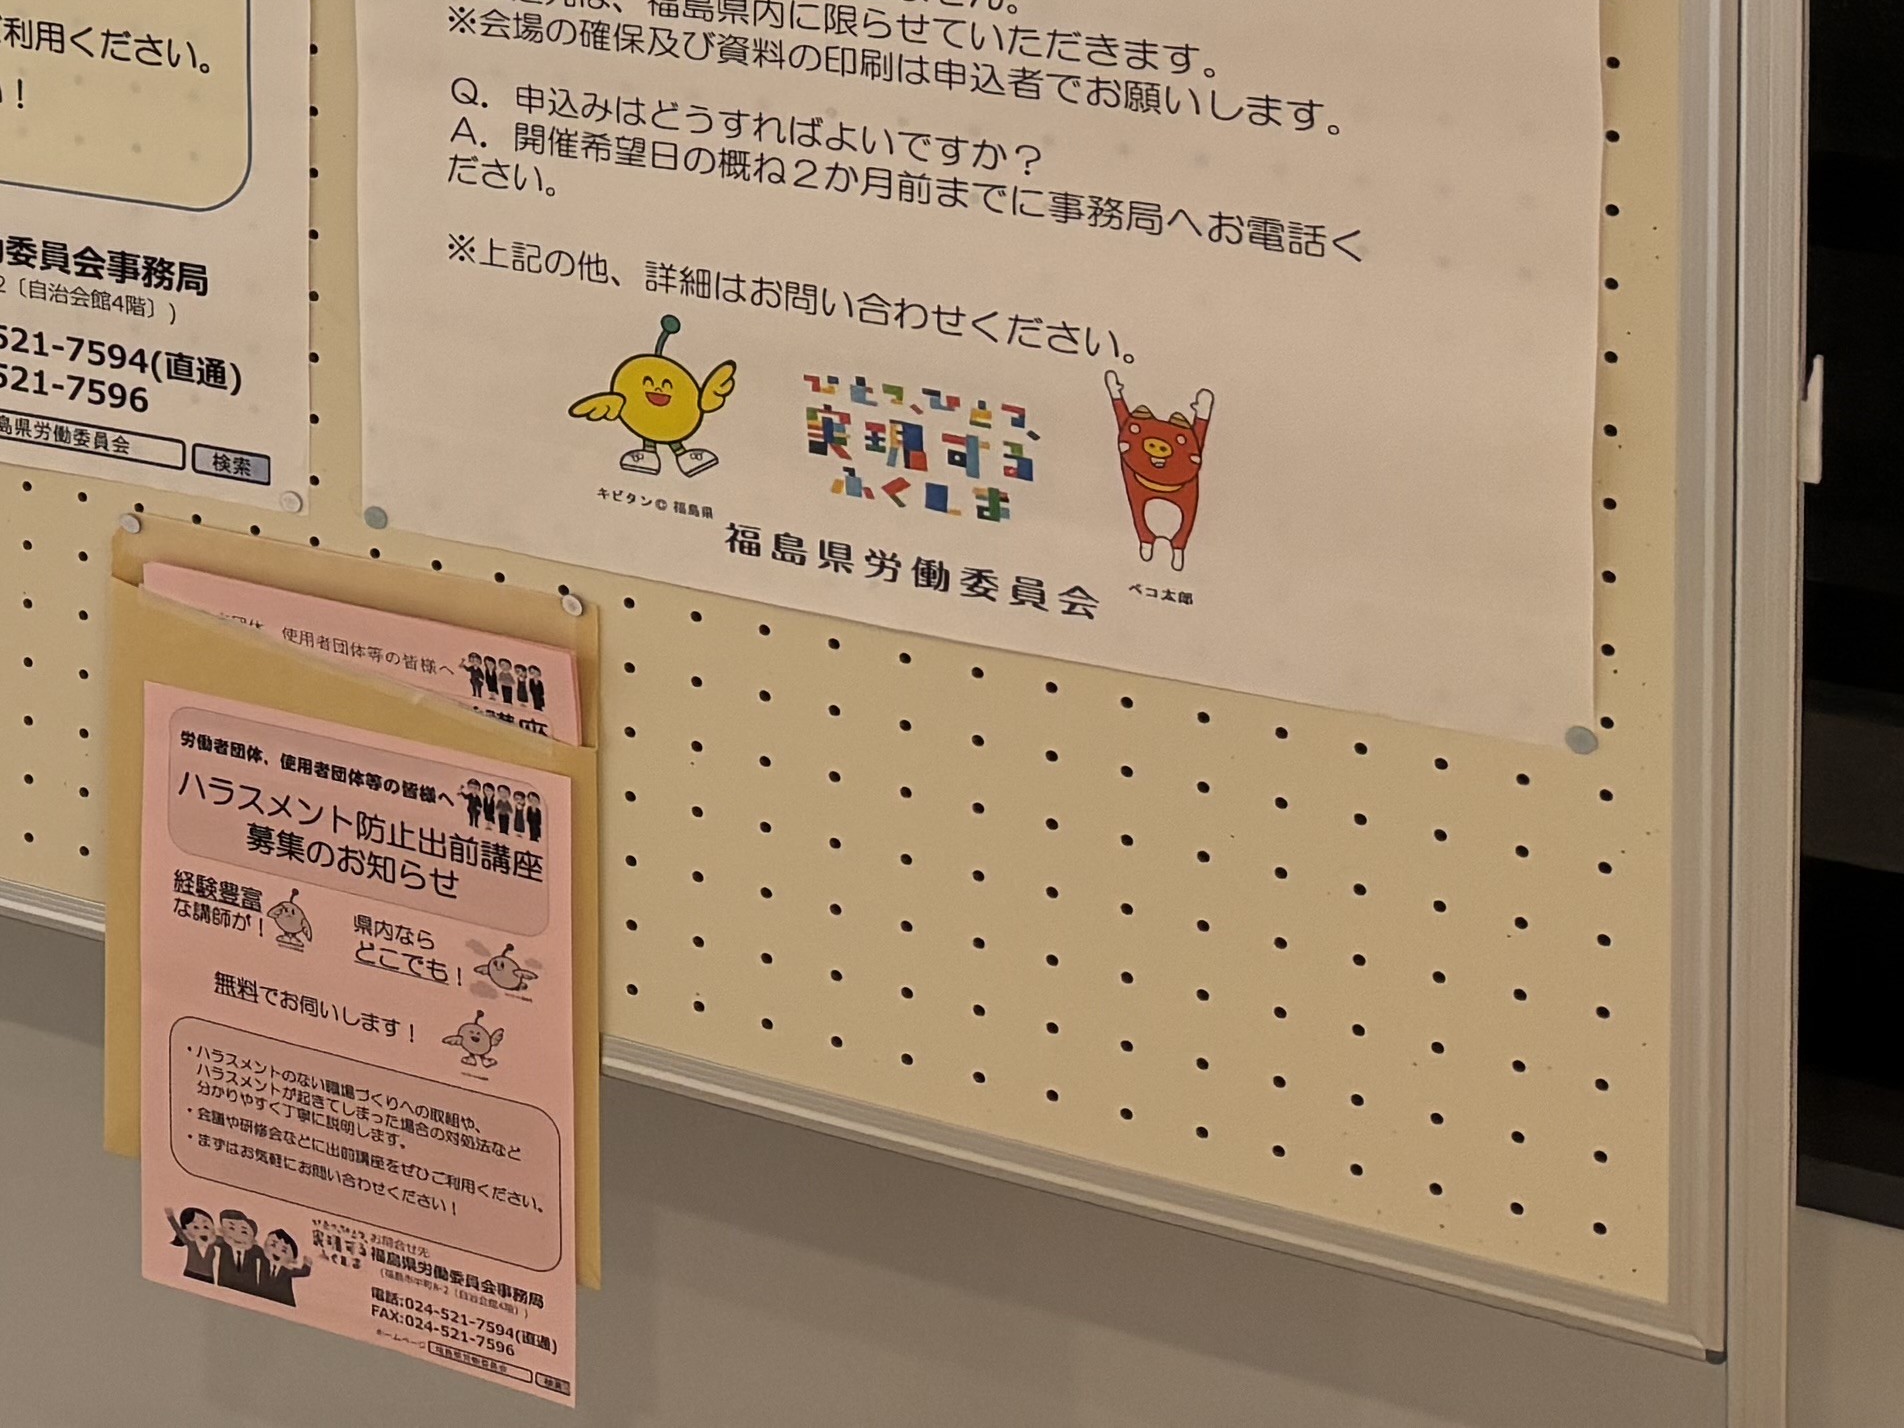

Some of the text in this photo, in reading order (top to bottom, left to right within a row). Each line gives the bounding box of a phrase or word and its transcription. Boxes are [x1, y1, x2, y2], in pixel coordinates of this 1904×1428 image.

[447, 9, 1343, 136] ※会場の確保及び資料の印刷は申込者でお願いします。
[447, 155, 559, 199] ださい。
[446, 235, 1137, 365] ※上記の他、詳細はお問い合わせください。
[211, 451, 252, 478] 検索
[805, 405, 1036, 485] 実現する
[673, 498, 715, 523] 福島県
[829, 466, 1013, 525] ふくしま
[723, 520, 1101, 623] 福島県労働委員会
[1127, 581, 1195, 608] ベコ太郎
[180, 729, 455, 807] 労働者団体、使用者団体等の皆様へ
[178, 770, 544, 885] ハラスメント防止出前講座
[246, 822, 460, 900] 募集のお知らせ
[173, 868, 263, 914] 経験豊富
[173, 897, 265, 937] な講師が！
[352, 914, 435, 950] 県内なら
[353, 941, 464, 988] どこでも！
[213, 970, 416, 1042] 無料でお伺いします！
